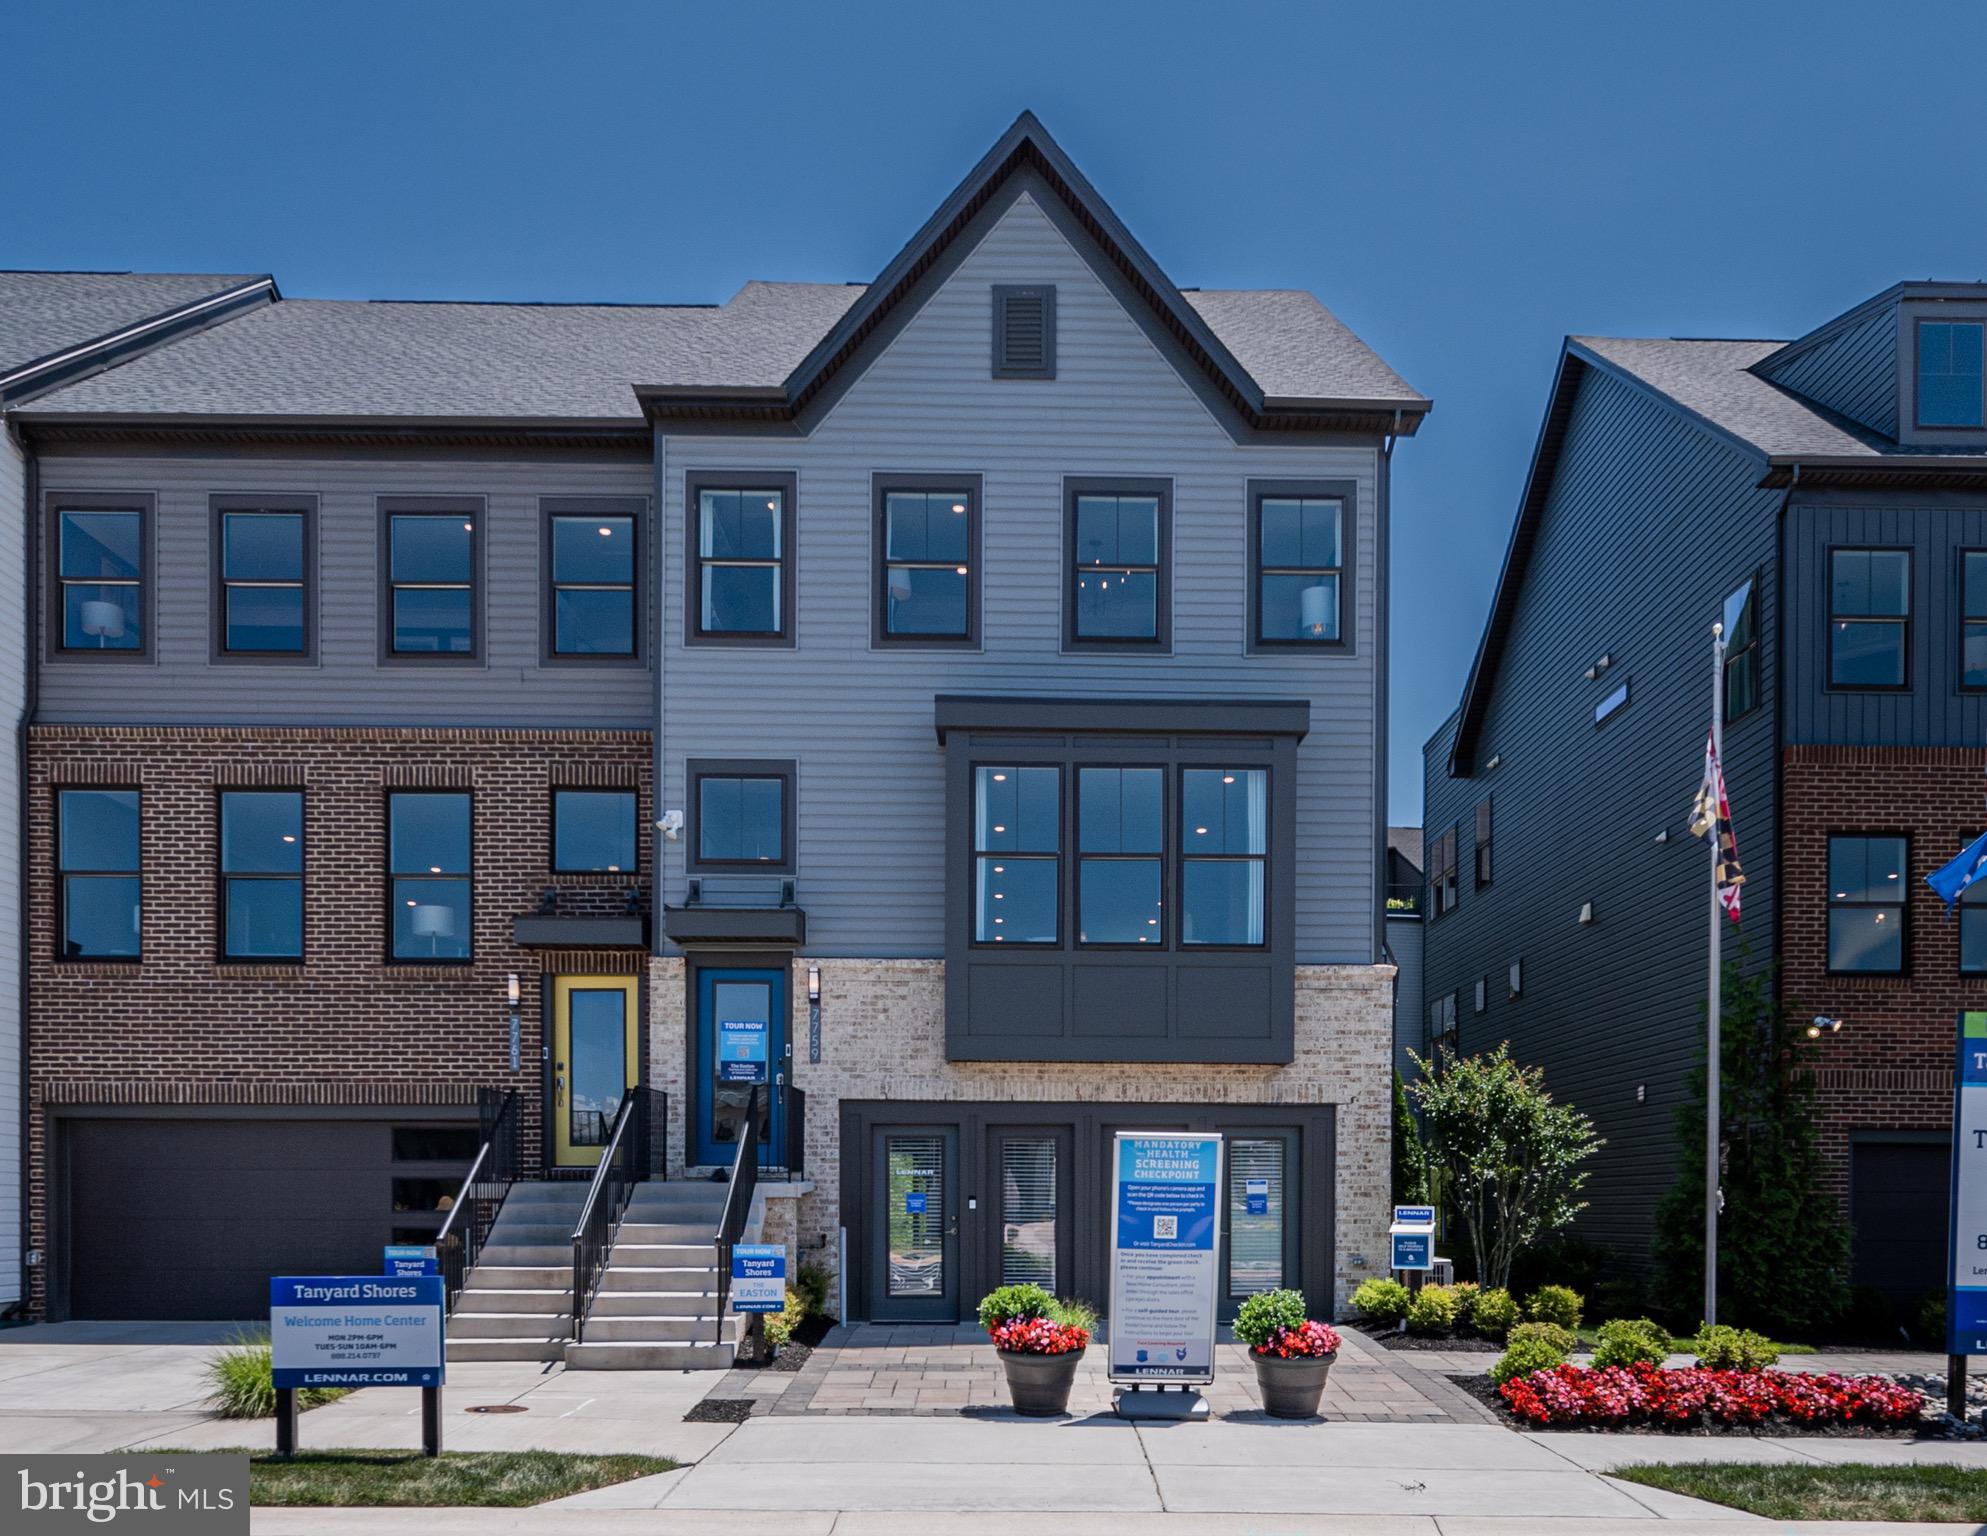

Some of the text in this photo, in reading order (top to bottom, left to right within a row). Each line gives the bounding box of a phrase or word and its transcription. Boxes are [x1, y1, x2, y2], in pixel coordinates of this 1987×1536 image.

[724, 1022, 763, 1030] TOUR NOW
[811, 1008, 819, 1059] 7759
[511, 1018, 519, 1068] 7761
[1134, 1140, 1201, 1149] MANDATORY
[1147, 1150, 1188, 1159] HEALTH
[1136, 1159, 1200, 1169] SCREENING
[1134, 1169, 1200, 1179] CHECKPOINT
[393, 1260, 425, 1269] Tanyard
[742, 1259, 775, 1269] Tanyard
[397, 1269, 422, 1277] Shores
[745, 1268, 772, 1277] Shores
[294, 1284, 417, 1301] Tanyard Shores
[740, 1289, 777, 1297] EASTON
[284, 1314, 427, 1327] Welcome Home Center
[304, 1373, 408, 1383] LENNAR.COM
